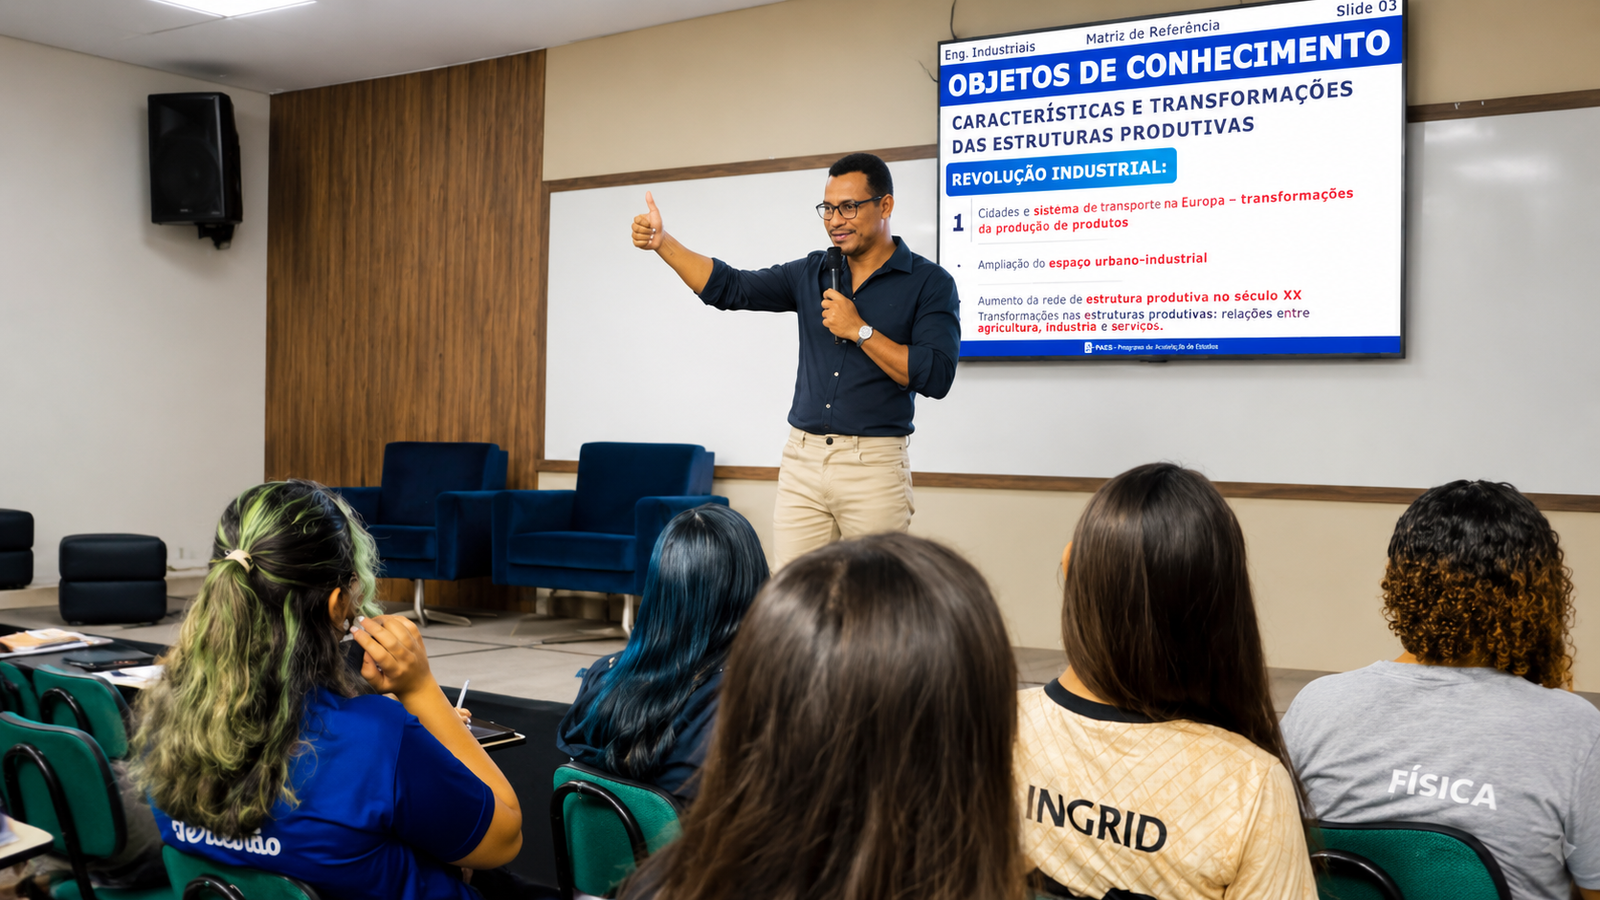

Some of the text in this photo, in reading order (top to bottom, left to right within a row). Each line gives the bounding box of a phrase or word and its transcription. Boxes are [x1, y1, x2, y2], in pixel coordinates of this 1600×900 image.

[1336, 0, 1397, 17] Slide 03
[1086, 19, 1220, 45] Matriz de Referência
[945, 42, 1036, 62] Eng. Industriais
[948, 29, 1391, 97] OBJETOS DE CONHECIMENTO
[952, 78, 1353, 130] CARACTERÍSTICAS E TRANSFORMAÇÕES
[952, 116, 1255, 154] DAS ESTRUTURAS PRODUTIVAS
[951, 160, 1167, 186] REVOLUÇÃO INDUSTRIAL:
[978, 207, 1020, 219] Cidades
[1023, 208, 1030, 217] e
[1033, 204, 1079, 216] sistema
[1083, 203, 1098, 213] de
[1100, 199, 1161, 213] transporte
[1164, 200, 1178, 209] na
[1181, 196, 1225, 209] Europa
[1240, 187, 1354, 205] transformações
[952, 213, 964, 232] 1
[978, 217, 1129, 235] da produção de produtos
[978, 252, 1208, 271] Ampliação do espaço urbano-industrial
[978, 289, 1302, 306] Aumento da rede de estrutura produtiva no século XX
[978, 308, 1310, 322] Transformações nas estruturas produtivas: relações entre
[977, 321, 1164, 335] agricultura, industria e serviços.
[1387, 764, 1497, 811] FÍSICA
[1026, 784, 1167, 853] INGRID
